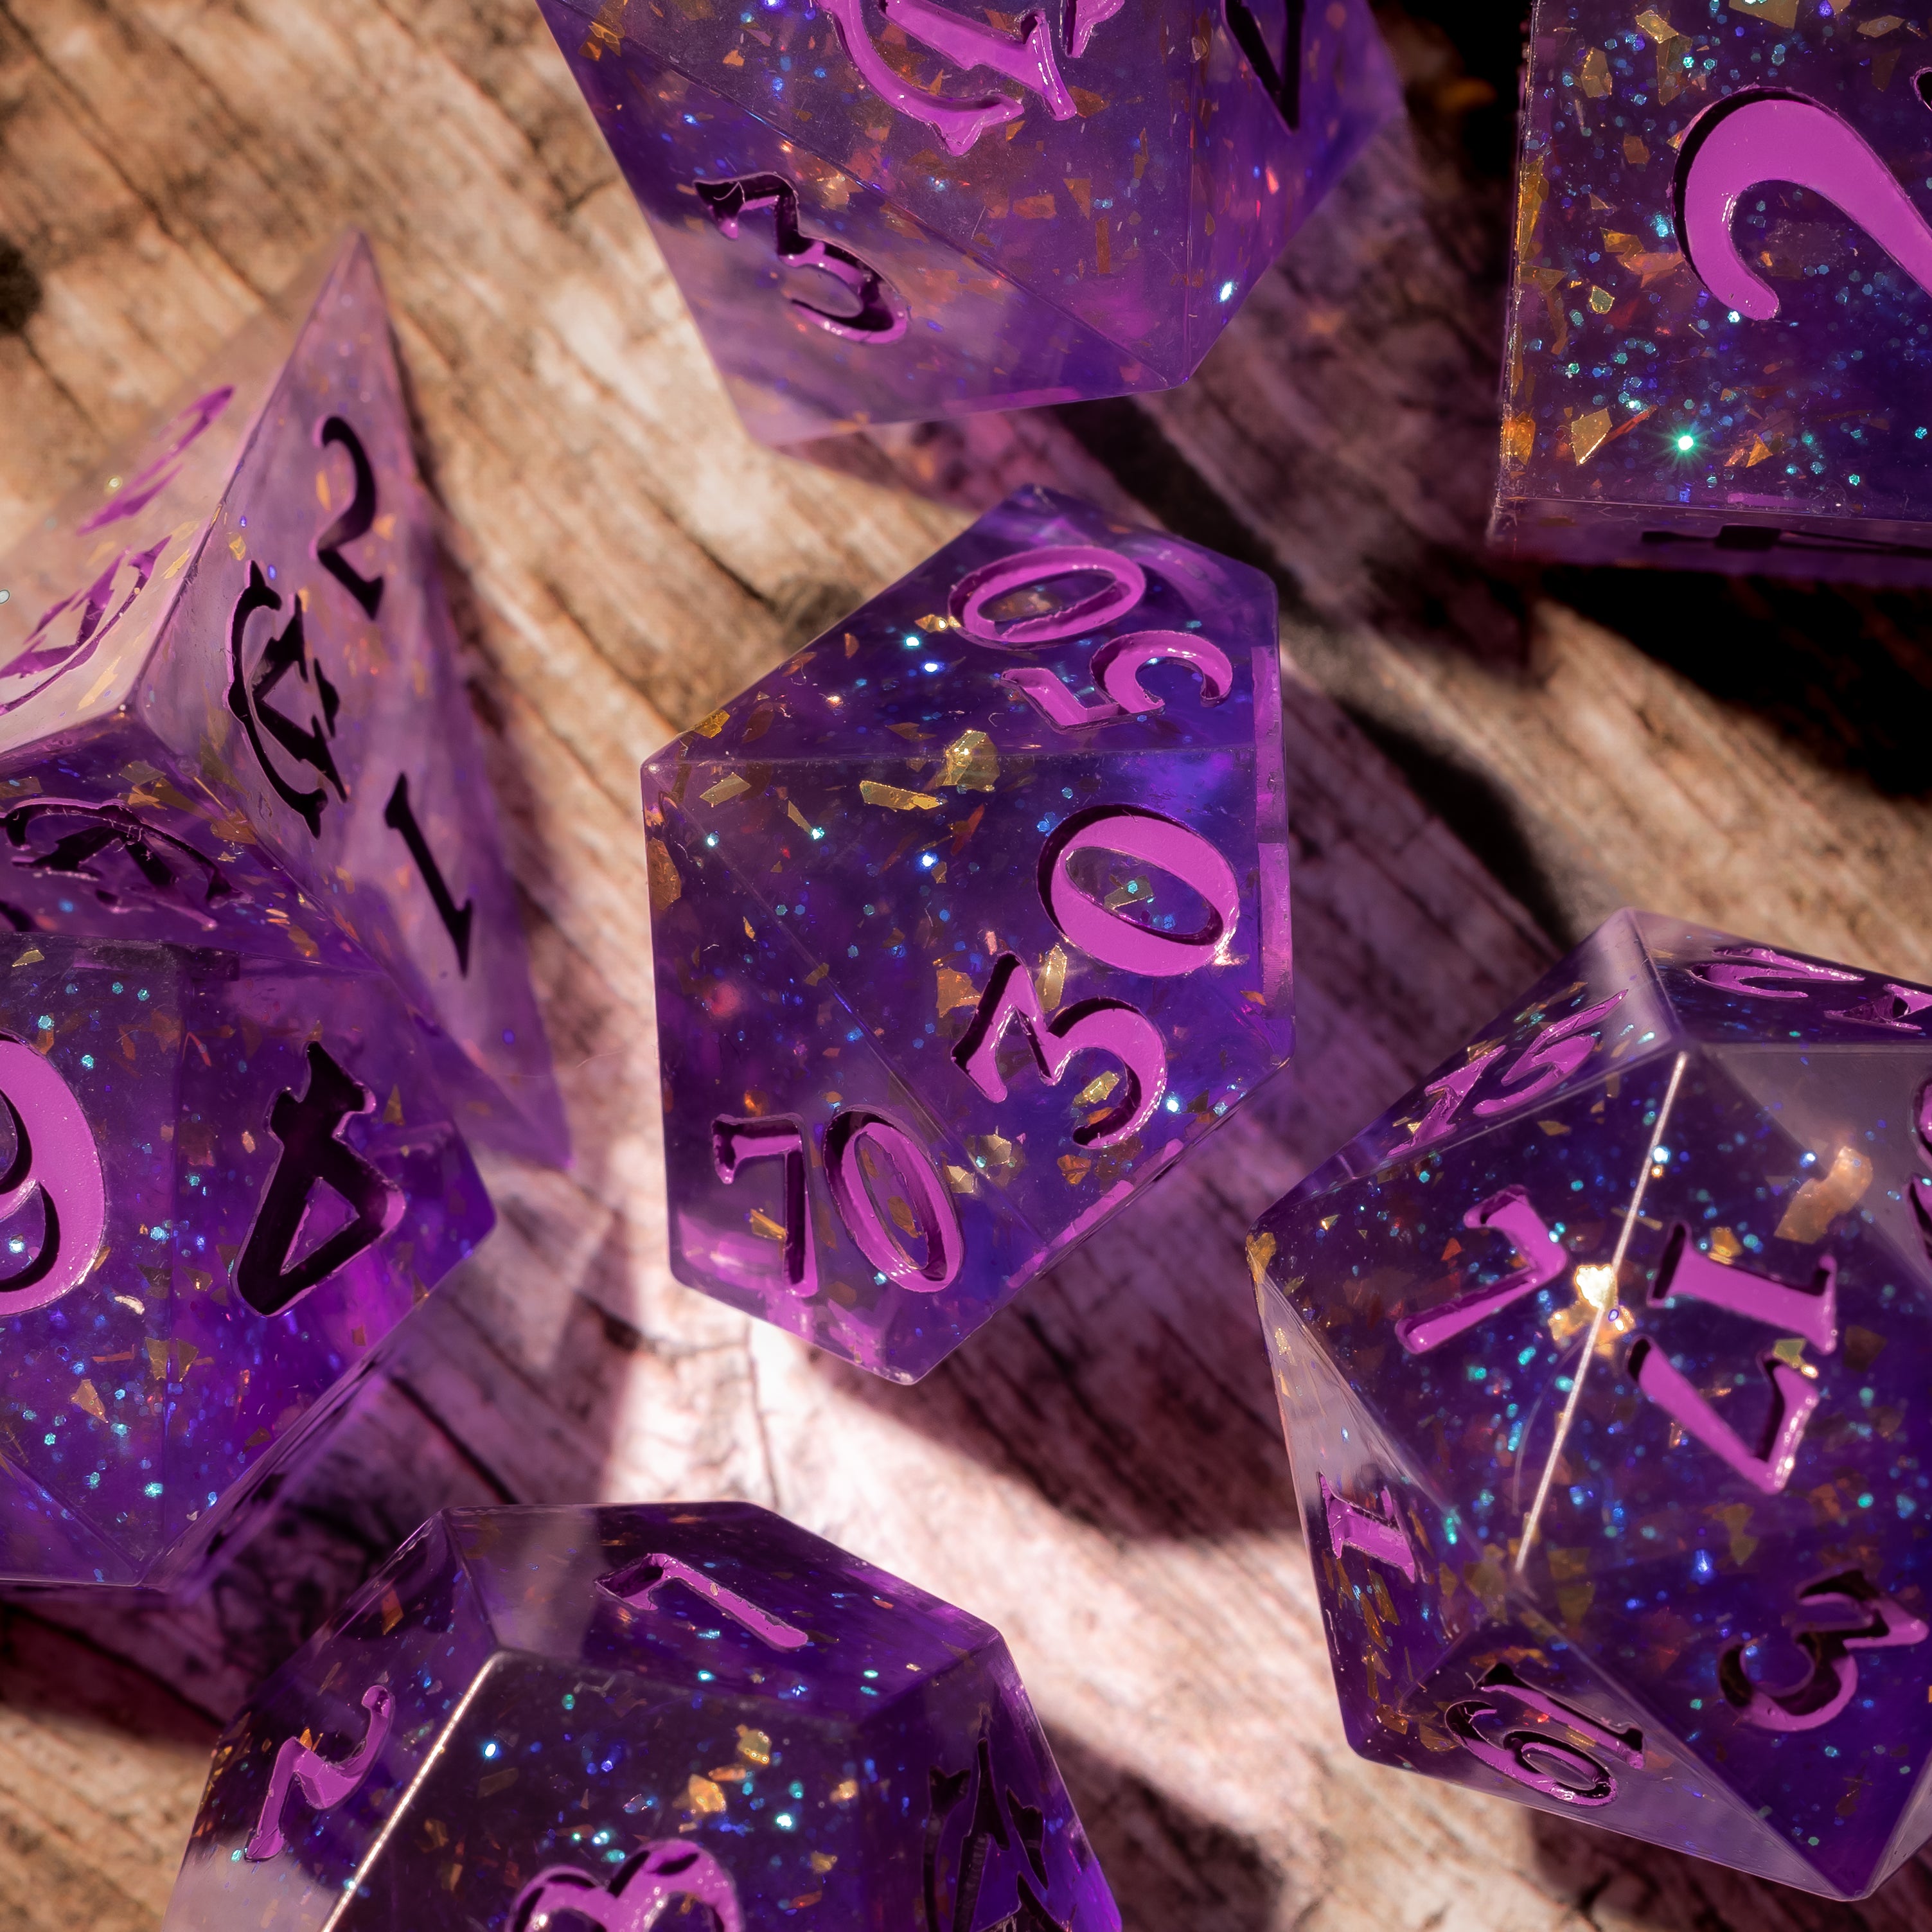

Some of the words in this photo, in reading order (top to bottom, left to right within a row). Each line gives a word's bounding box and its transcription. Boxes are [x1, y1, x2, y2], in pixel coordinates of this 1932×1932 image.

[694, 170, 910, 344] 3
[313, 415, 384, 621] 2
[948, 544, 1234, 731] 50
[384, 772, 474, 979] 1
[951, 802, 1240, 1153] 30
[1385, 988, 1629, 1158] 15
[230, 1040, 406, 1318] 4
[711, 1104, 965, 1300] 70
[1624, 1221, 1839, 1495] 17
[1717, 1568, 1929, 1733] 3
[246, 1683, 394, 1863] 2
